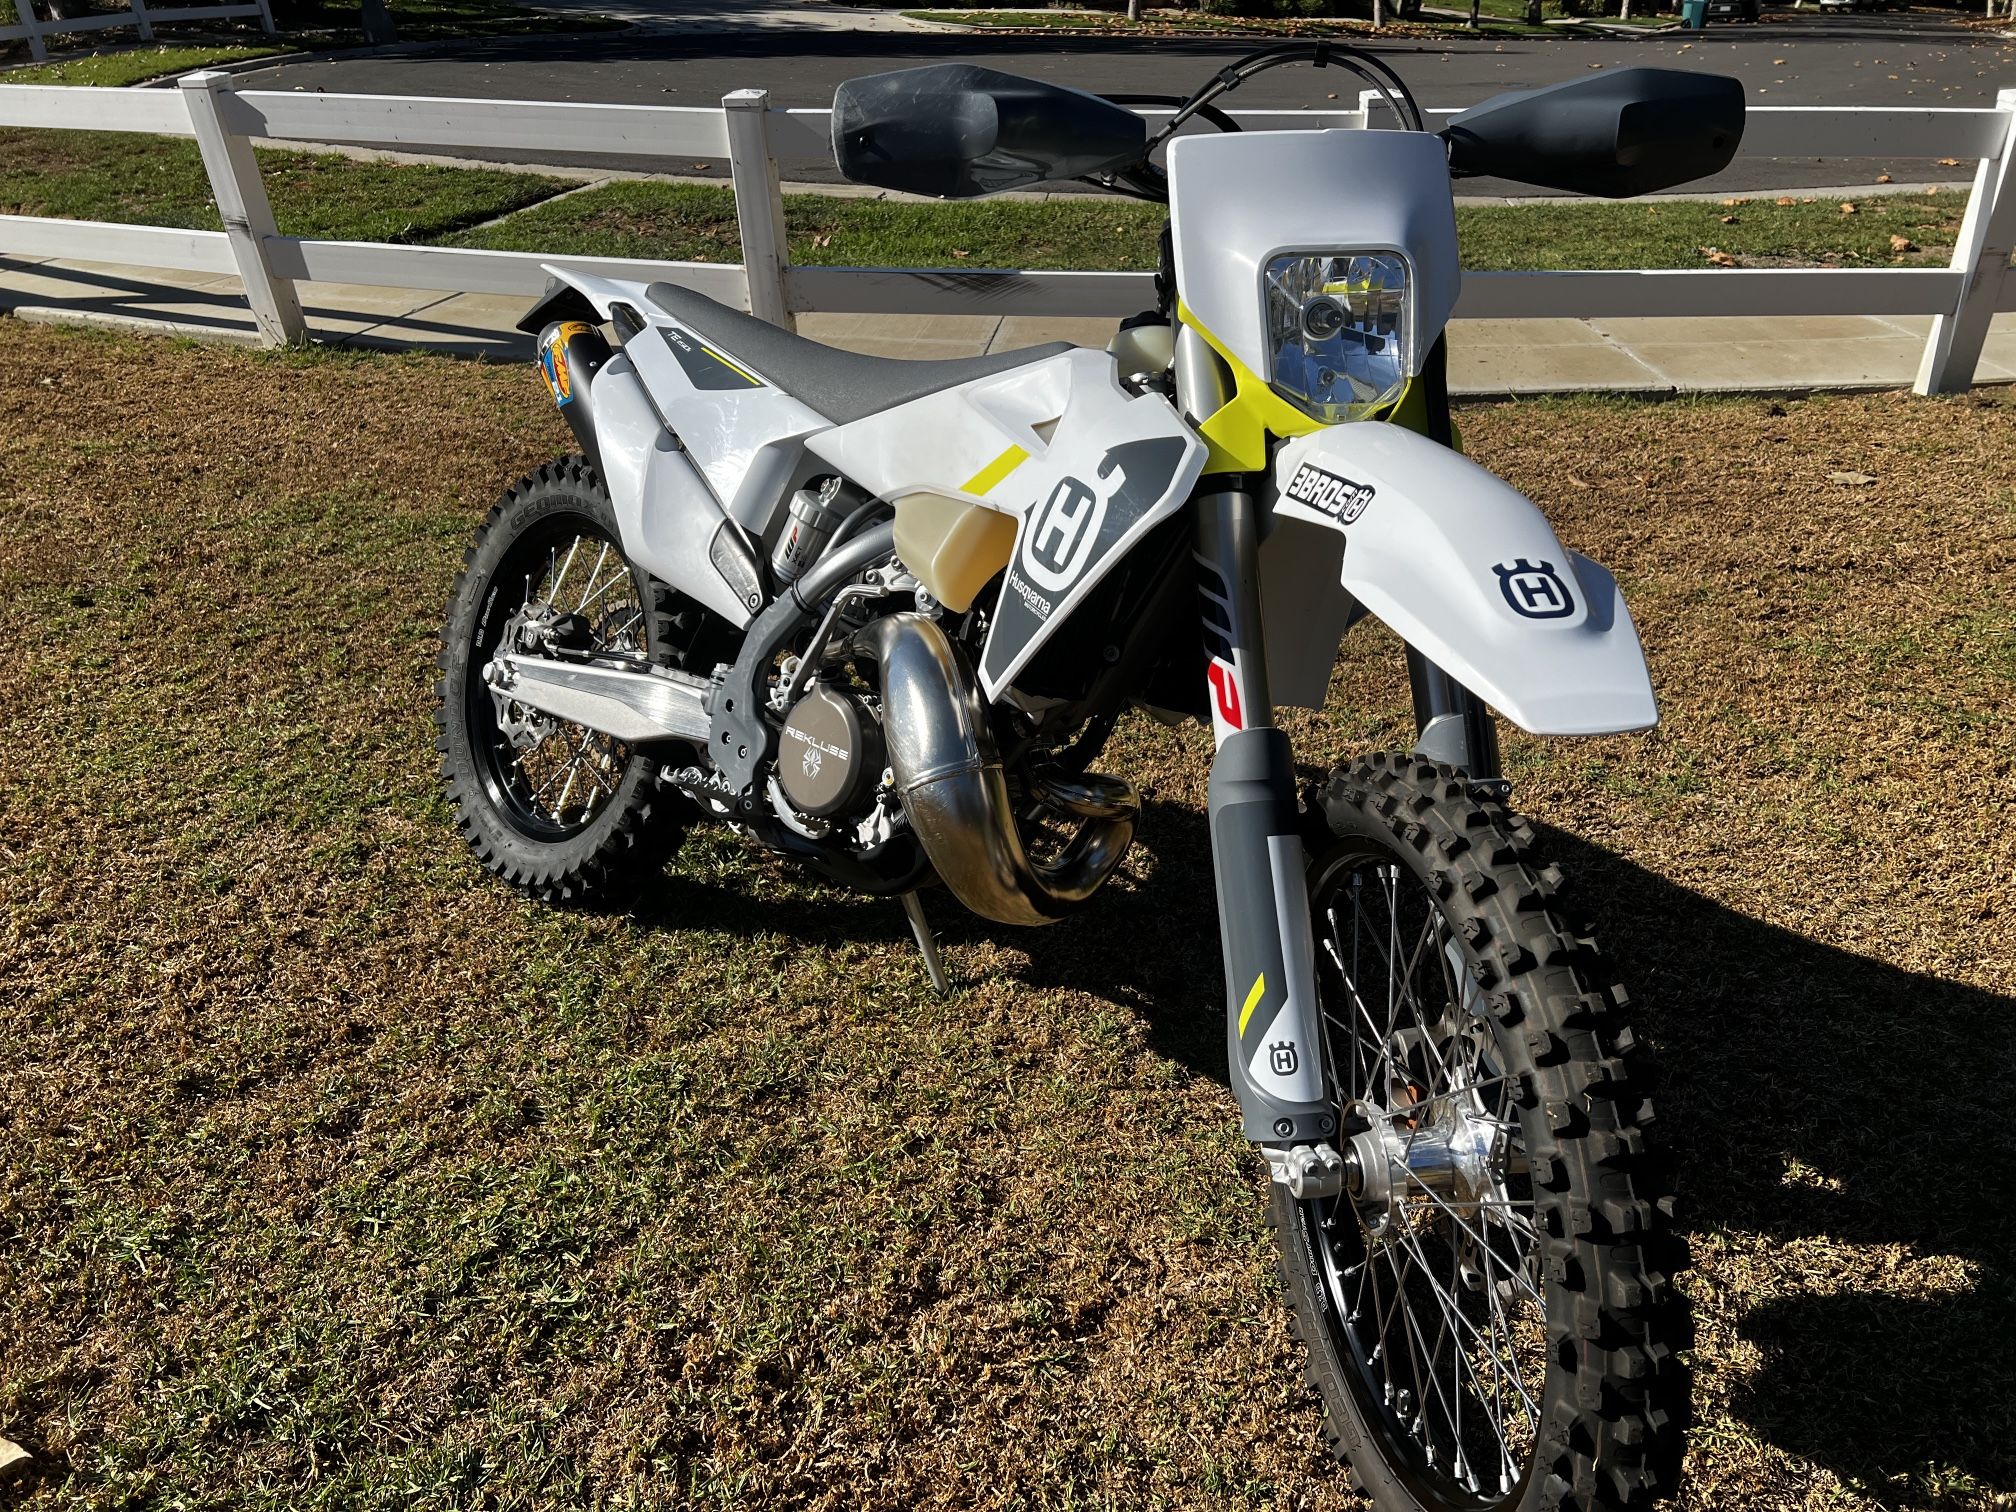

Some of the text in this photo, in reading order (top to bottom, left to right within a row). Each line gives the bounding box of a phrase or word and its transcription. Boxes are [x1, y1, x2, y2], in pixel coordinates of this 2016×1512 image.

[1288, 466, 1357, 515] 3BROS
[1009, 570, 1051, 615] Husqvarna
[785, 726, 849, 761] REKLUSE
